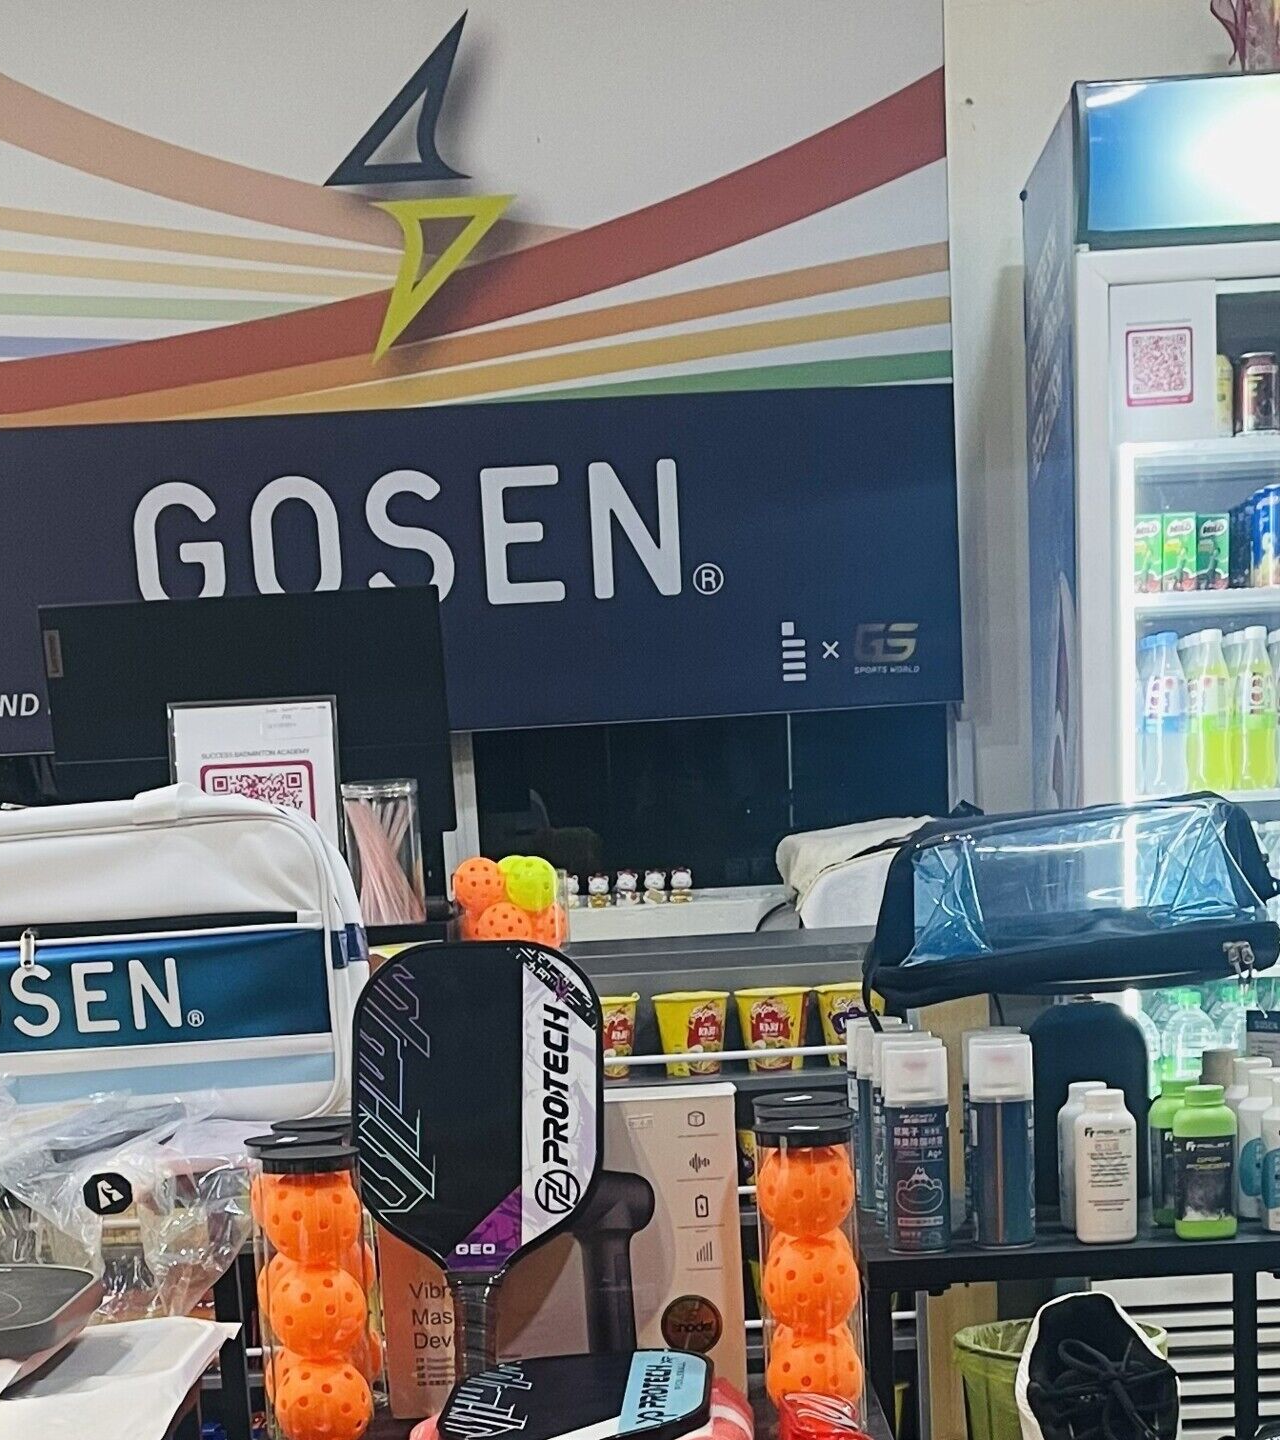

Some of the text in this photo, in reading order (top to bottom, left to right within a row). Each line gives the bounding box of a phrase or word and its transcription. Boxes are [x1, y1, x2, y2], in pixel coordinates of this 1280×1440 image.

[133, 458, 681, 606] GOSEN
[235, 750, 276, 758] BADMINTON
[277, 748, 310, 756] ACADEMY
[543, 1003, 570, 1164] PROTECH
[455, 1243, 496, 1255] GEO
